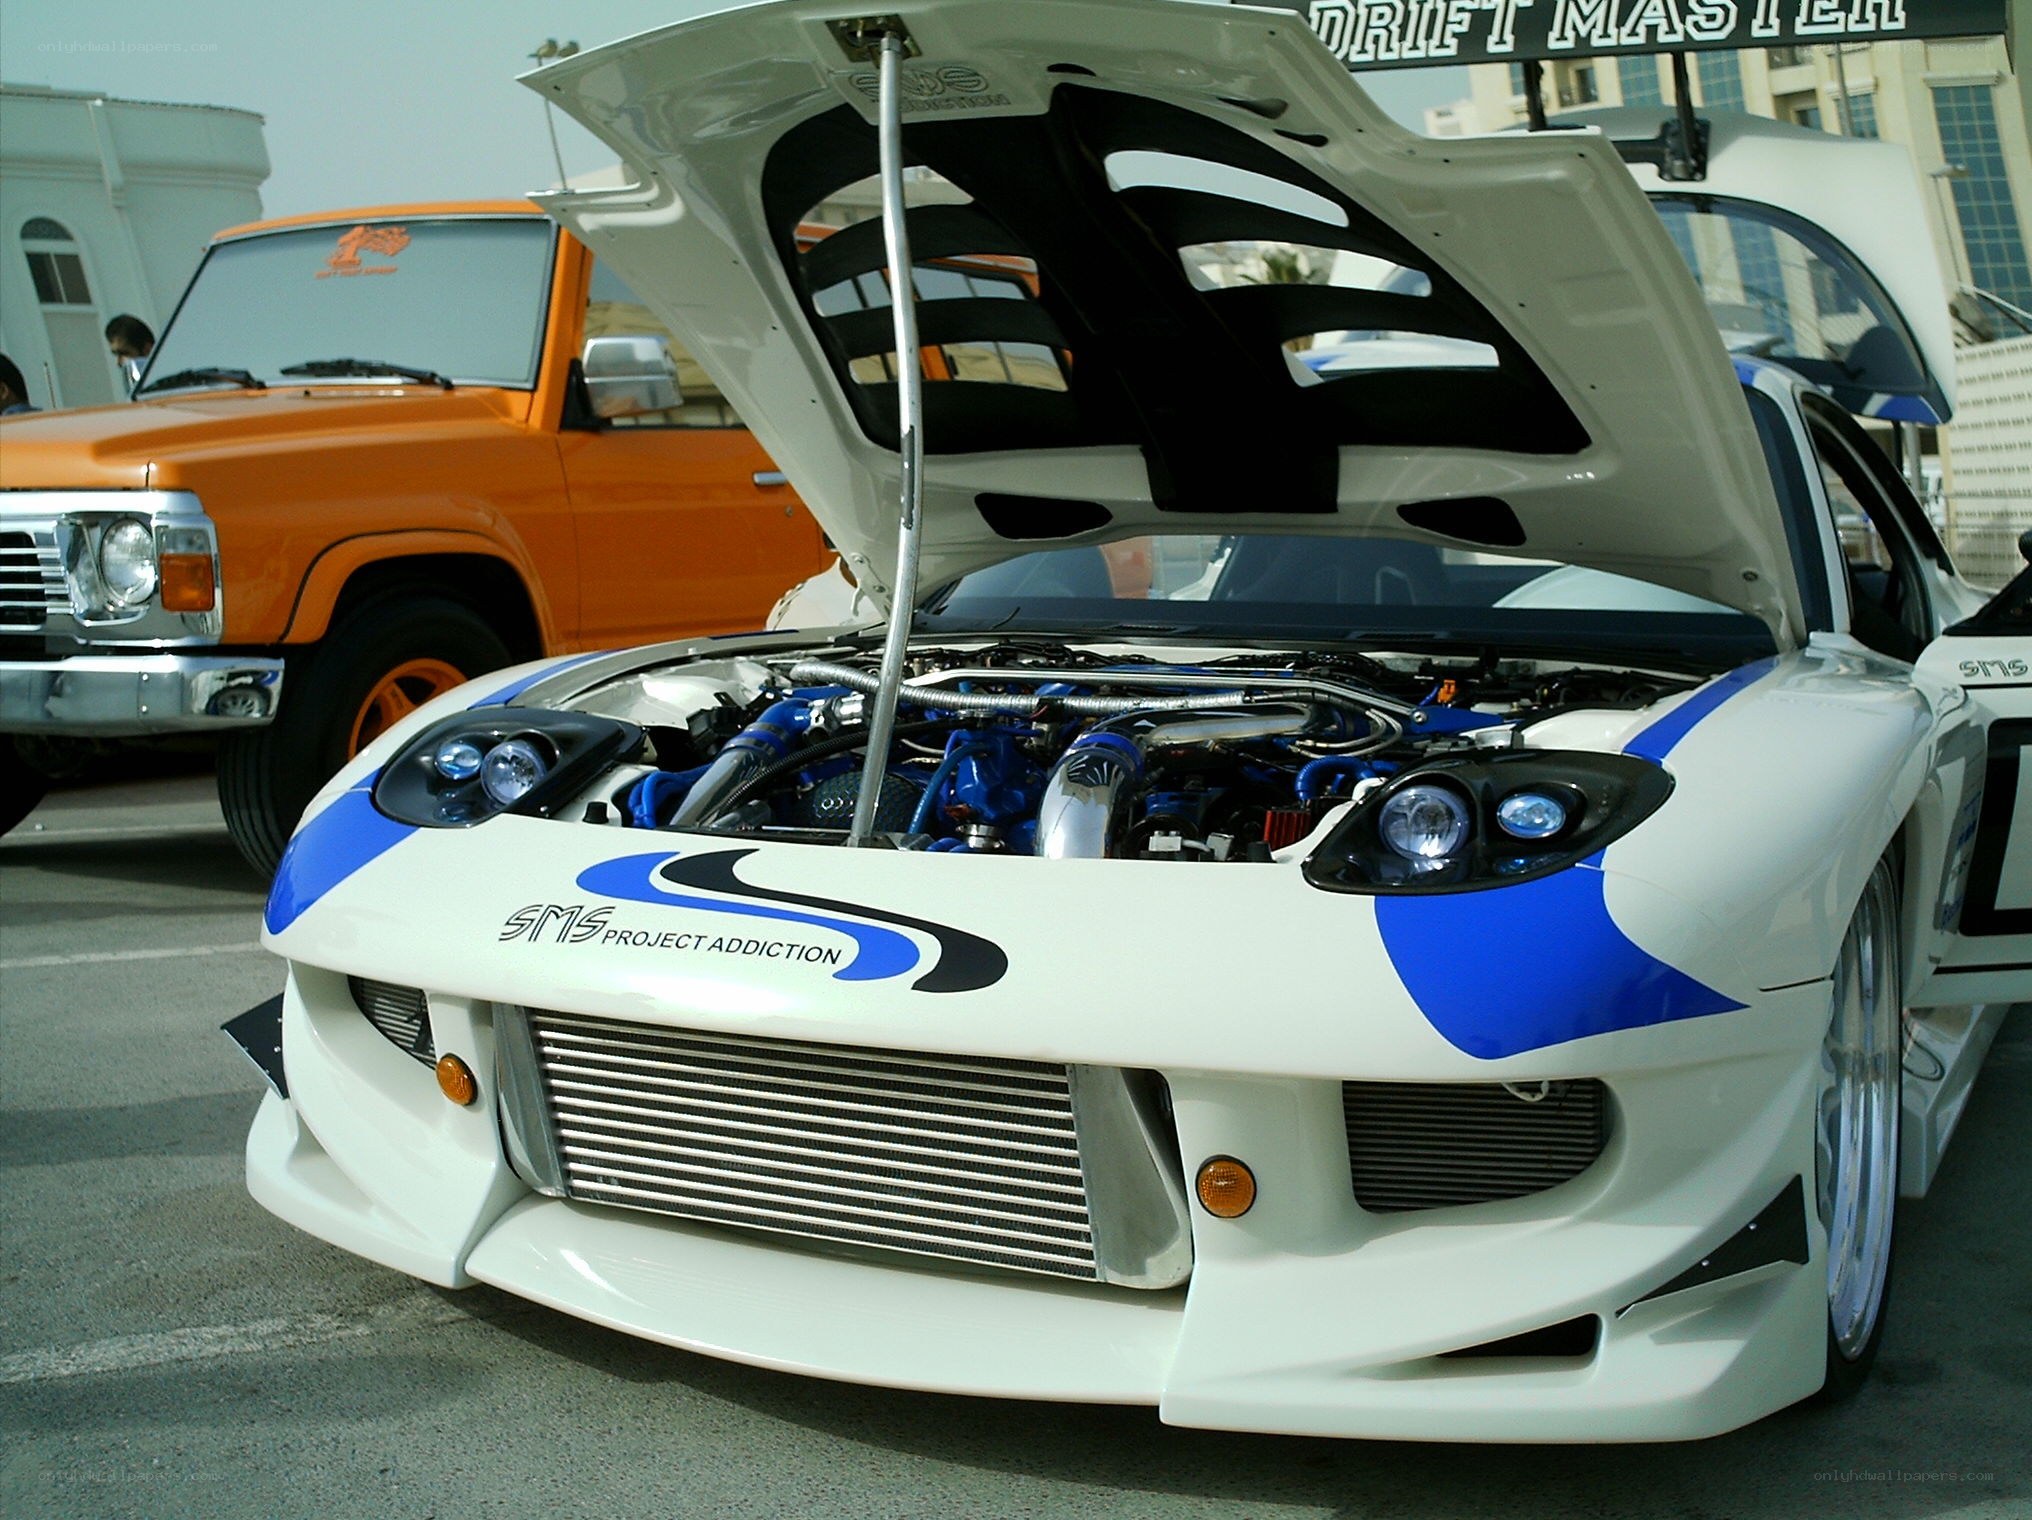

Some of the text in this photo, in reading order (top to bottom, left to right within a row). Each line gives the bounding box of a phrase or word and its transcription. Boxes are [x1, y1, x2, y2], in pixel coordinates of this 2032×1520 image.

[1309, 0, 1534, 62] DRIFT
[499, 904, 842, 965] SMS PROJECT ADDICTION
